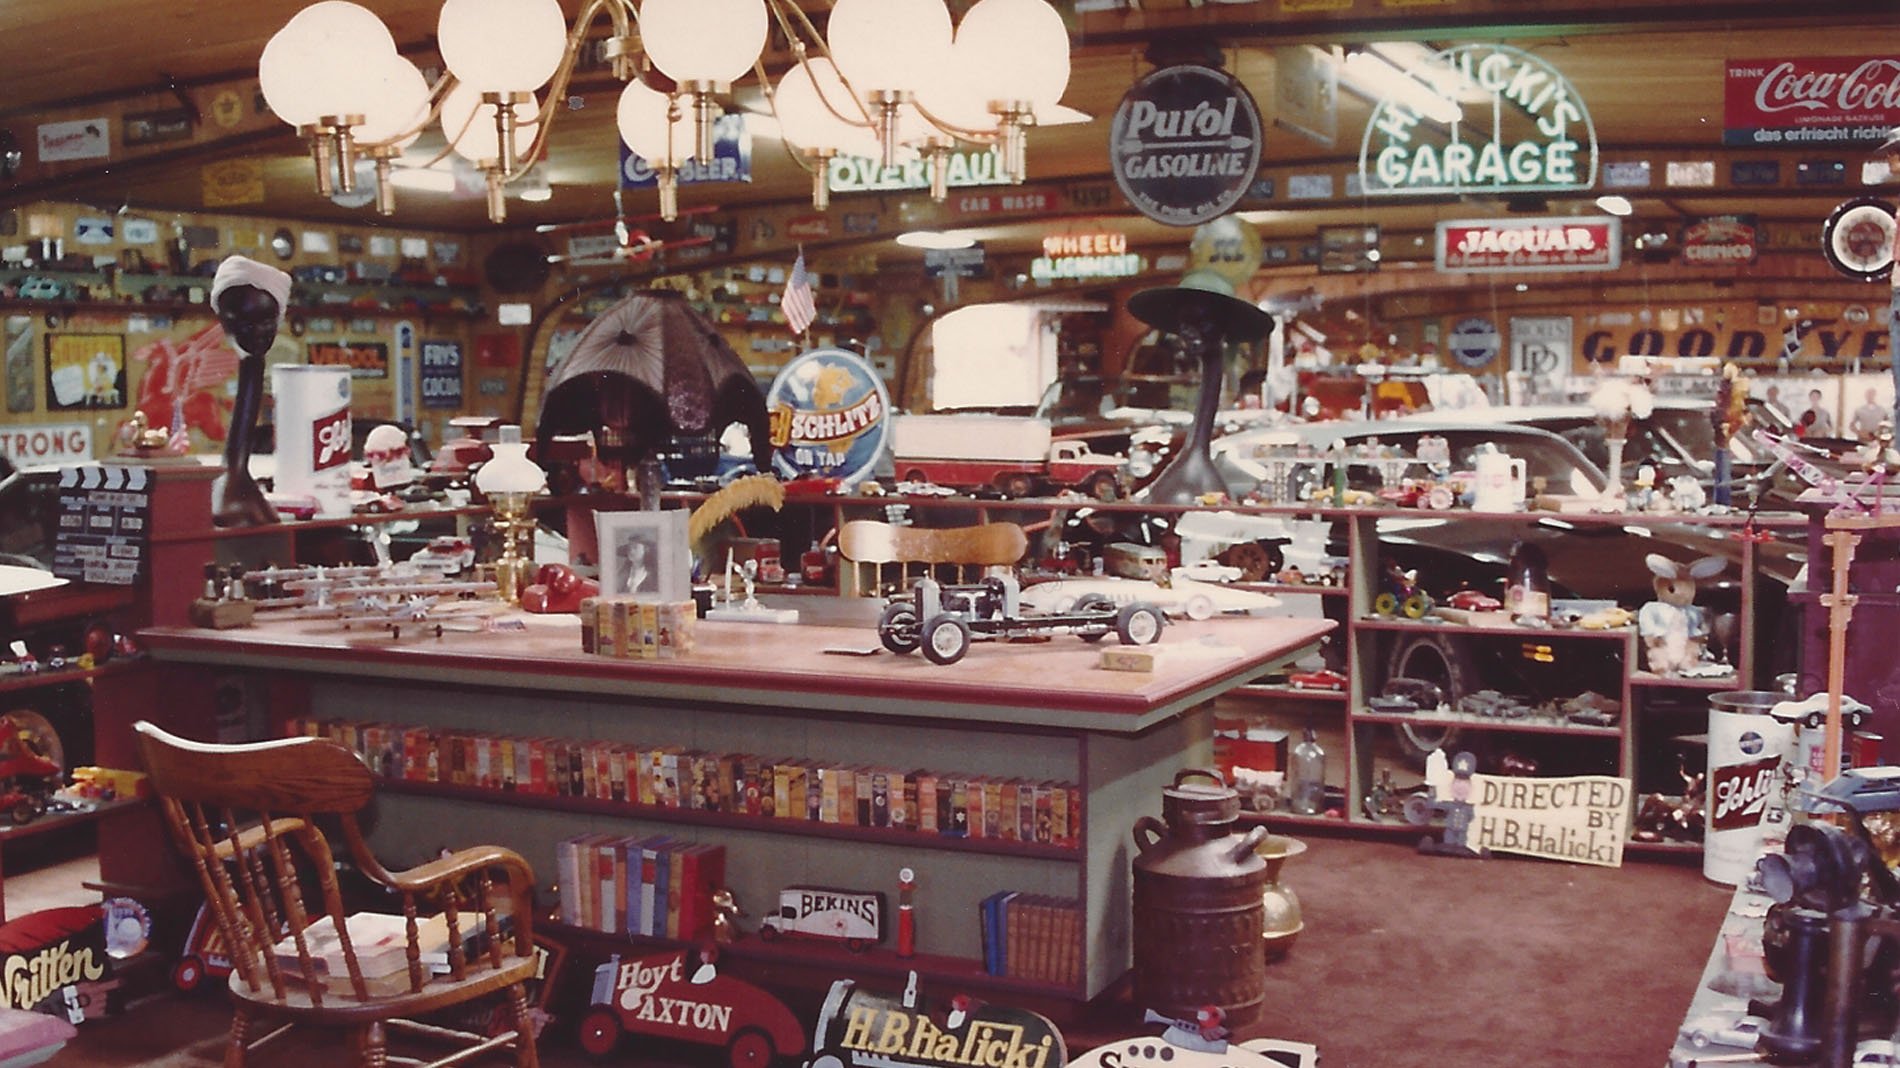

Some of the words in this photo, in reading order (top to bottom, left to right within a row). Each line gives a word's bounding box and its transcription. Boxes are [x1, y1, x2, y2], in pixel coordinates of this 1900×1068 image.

[1729, 68, 1765, 78] TRINK
[1755, 59, 1900, 112] Coca-Col
[1376, 53, 1581, 143] HICKI'S
[1126, 97, 1238, 138] Purol
[1753, 128, 1782, 142] das
[1785, 126, 1848, 141] erfrischt
[1853, 125, 1888, 139] richt
[830, 151, 1012, 188] OVERAUL
[1125, 153, 1245, 179] GASOLINE
[1376, 141, 1579, 185] GARAGE
[960, 197, 990, 212] CAR
[1002, 195, 1046, 210] WASH
[1458, 228, 1596, 253] JAGUAR
[423, 377, 460, 396] COCOA
[791, 394, 881, 440] SCHLITZ
[795, 448, 814, 465] ON
[816, 449, 846, 467] TAP
[1480, 780, 1625, 809] DIRECTED
[1587, 810, 1621, 830] BY
[801, 894, 875, 928] BEKINS
[618, 955, 682, 1010] Hoyt
[636, 996, 732, 1032] AXTON
